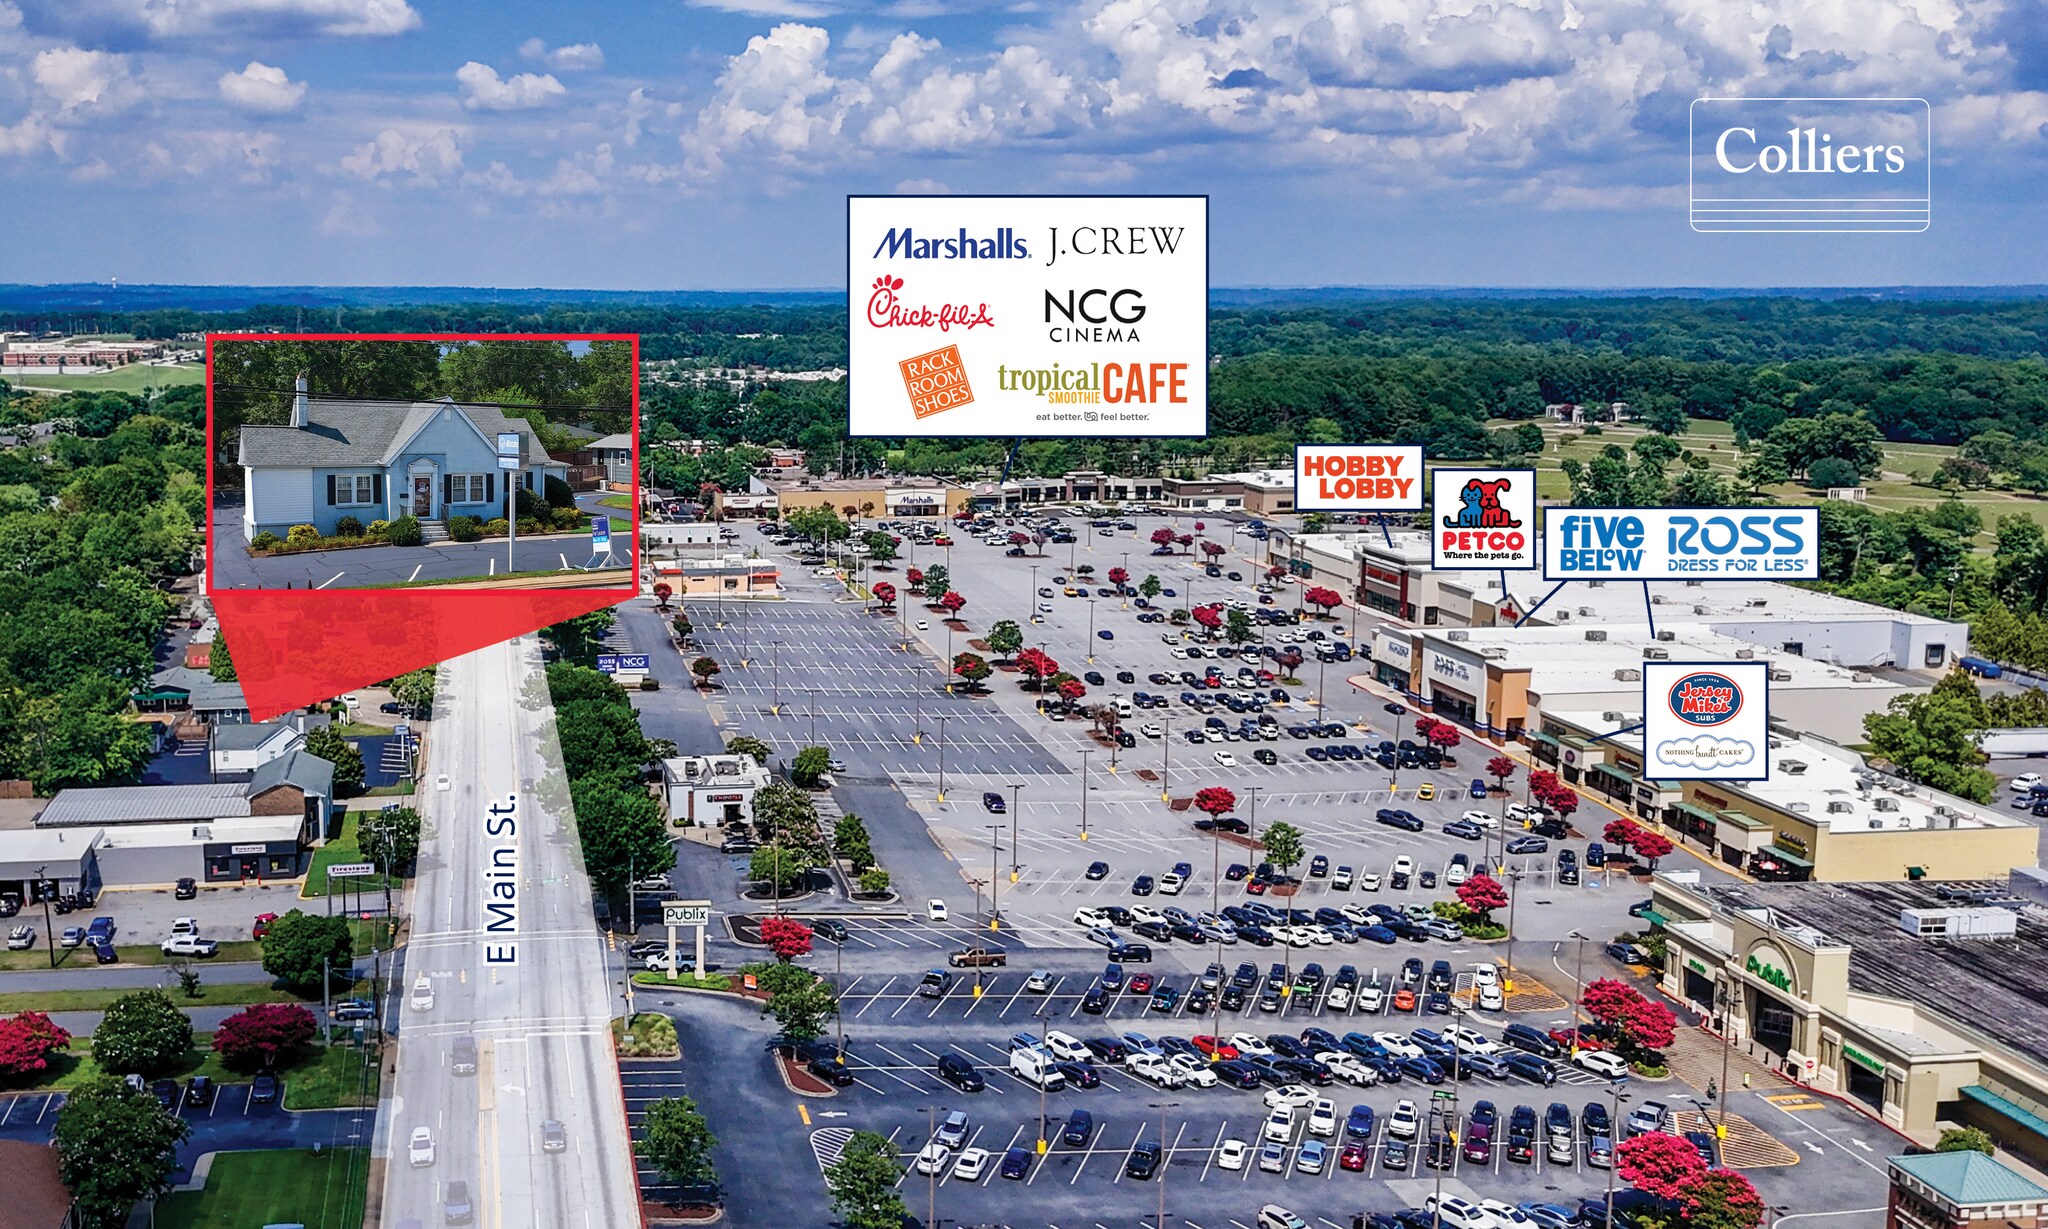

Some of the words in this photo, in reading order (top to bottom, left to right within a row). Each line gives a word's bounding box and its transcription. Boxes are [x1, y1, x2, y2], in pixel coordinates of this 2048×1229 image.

[900, 496, 934, 504] Marshalls
[622, 657, 645, 666] NCG
[666, 908, 706, 920] Publix
[1746, 954, 1793, 994] Publix
